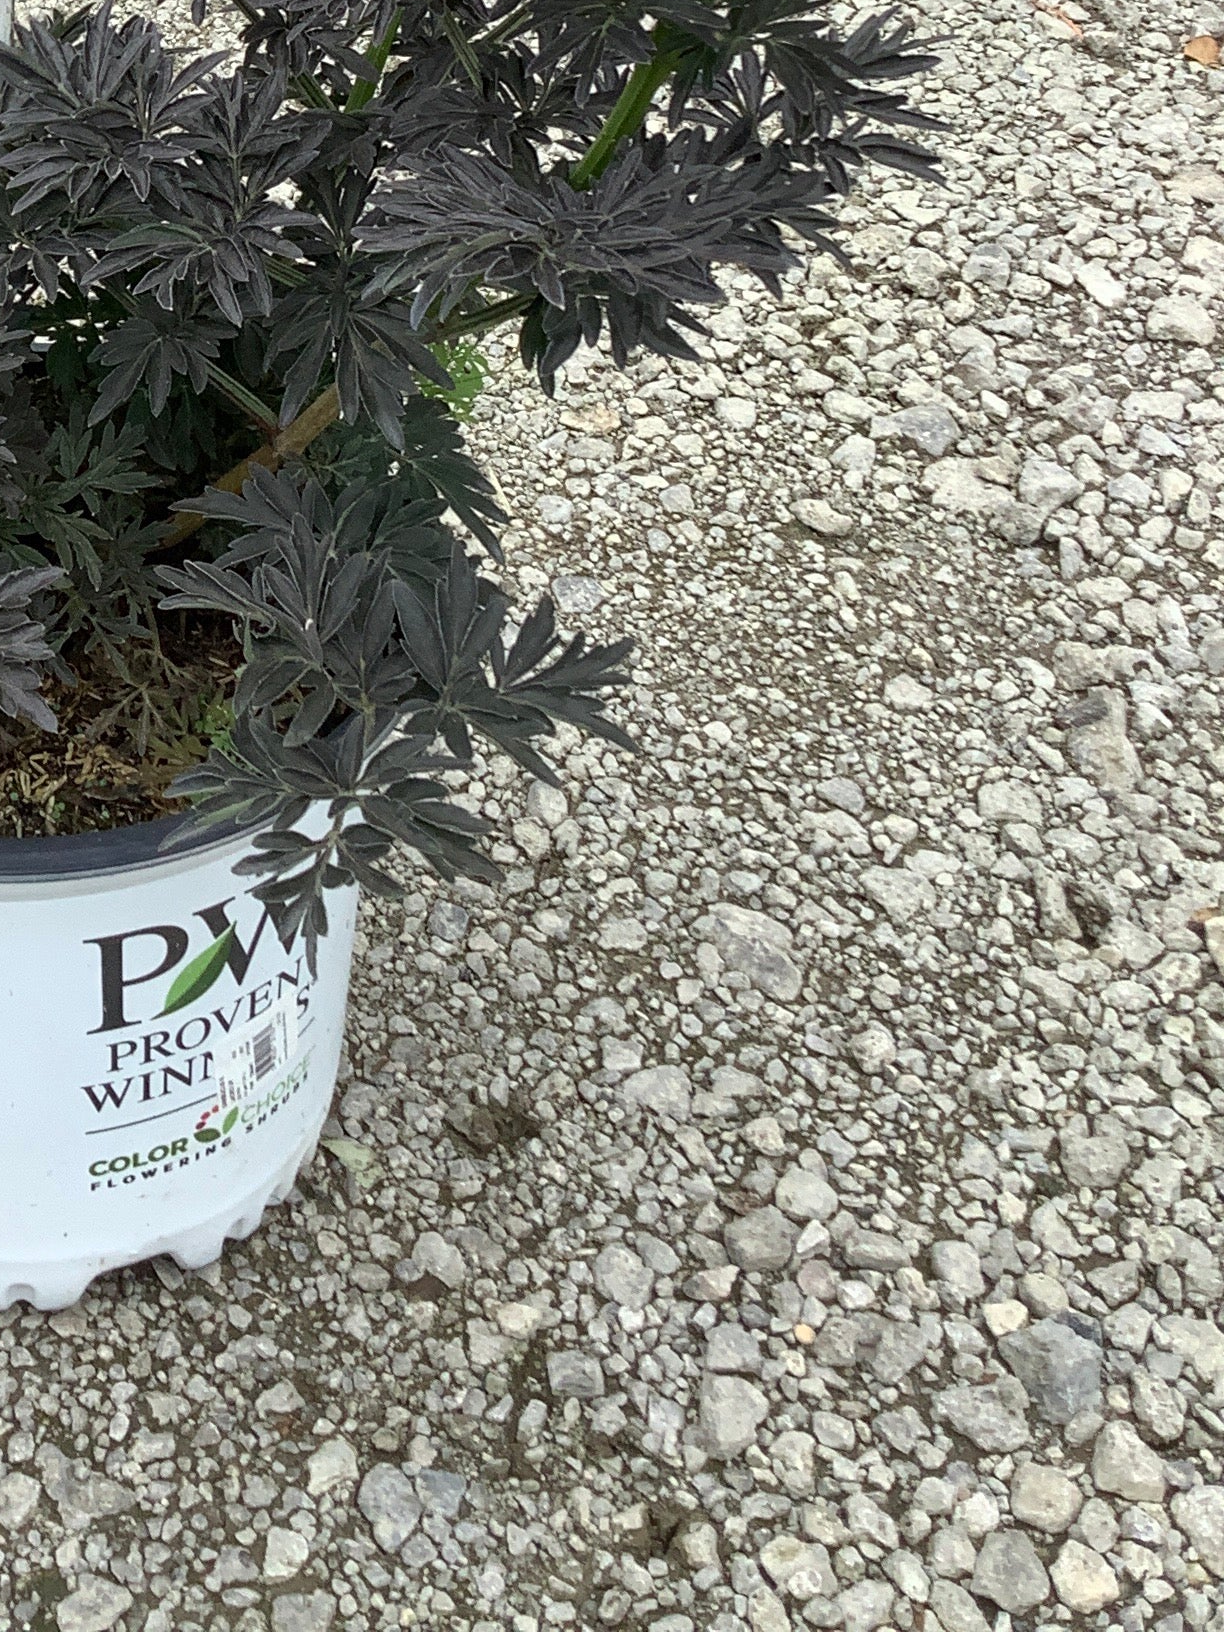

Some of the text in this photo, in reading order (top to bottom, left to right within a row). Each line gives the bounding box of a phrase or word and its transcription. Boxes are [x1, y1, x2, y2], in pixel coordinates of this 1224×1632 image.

[81, 984, 311, 1114] WINS
[106, 954, 305, 1074] PROVEN
[88, 1137, 189, 1177] COLOR
[241, 1053, 310, 1124] CHOICE
[90, 1136, 232, 1192] FLOWERING
